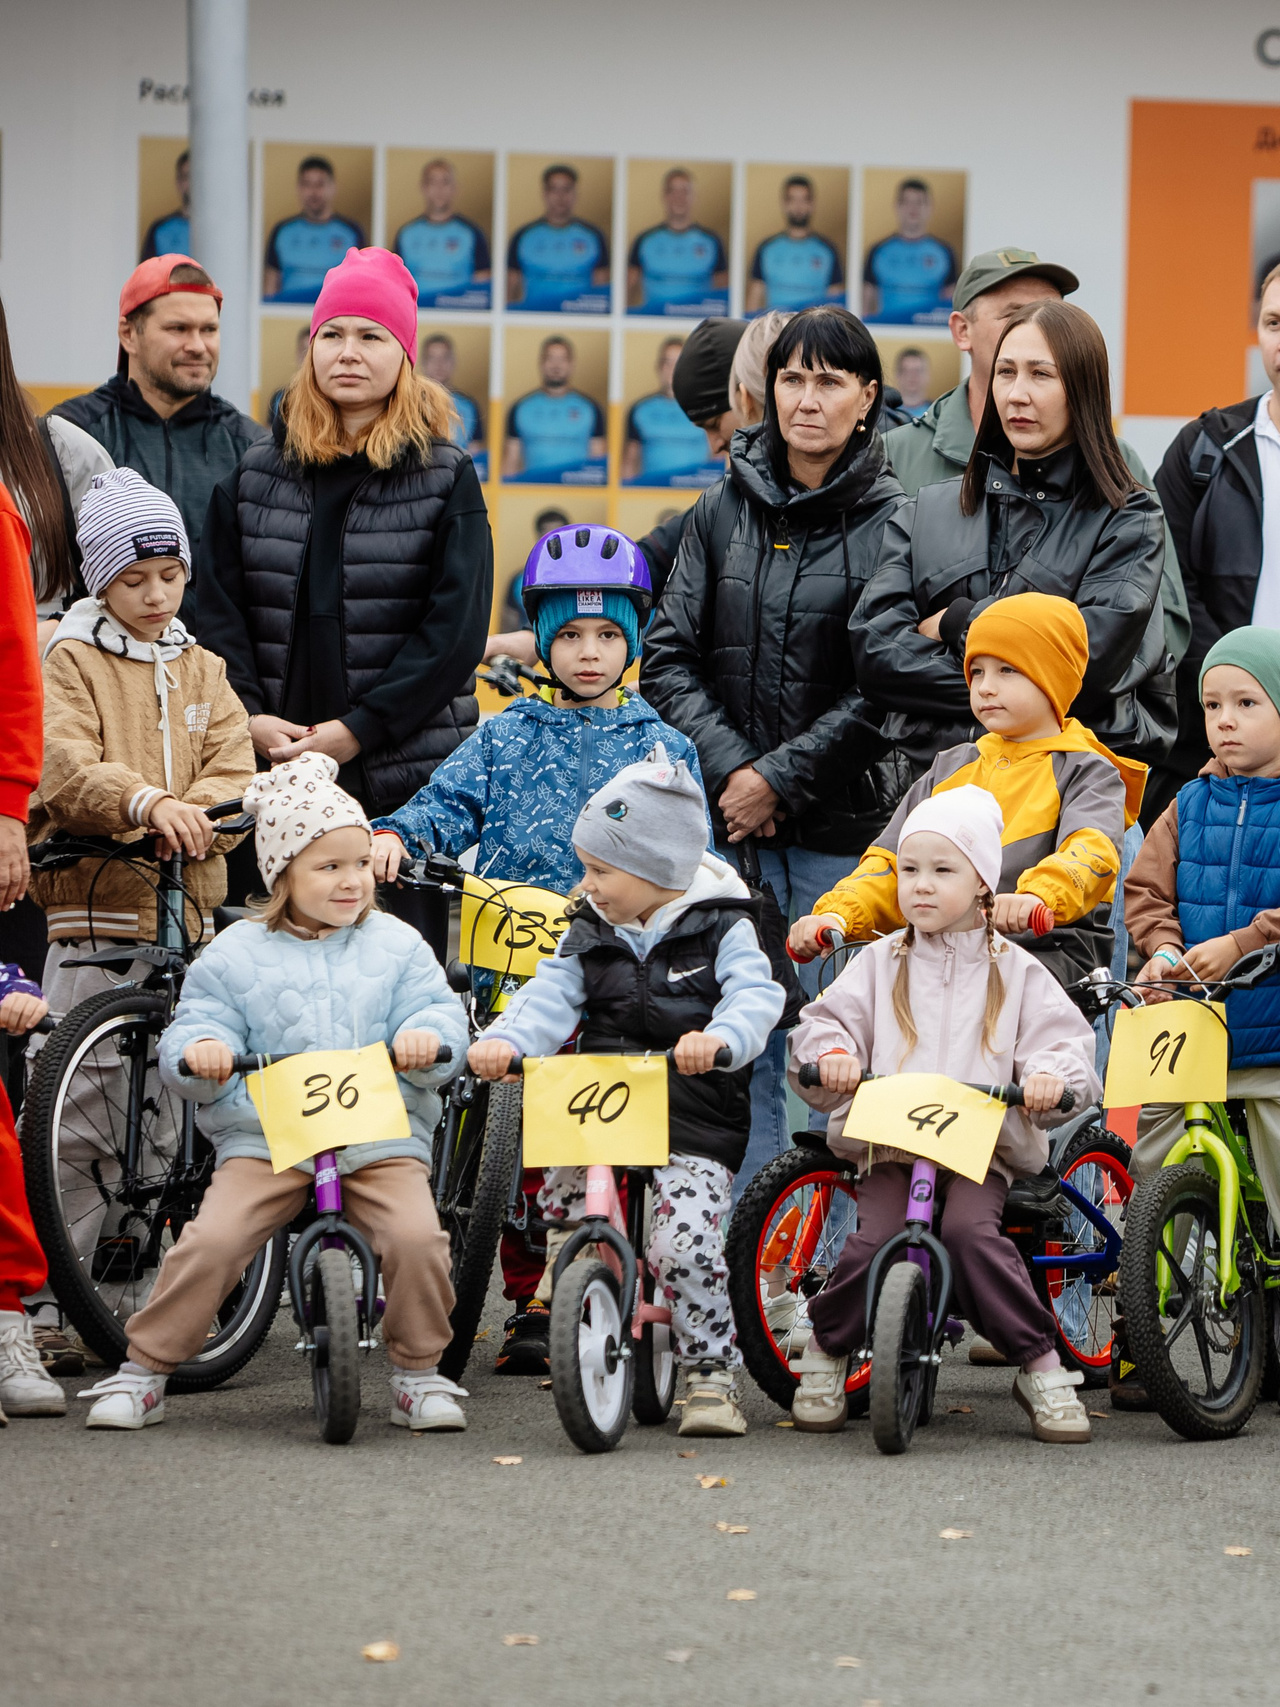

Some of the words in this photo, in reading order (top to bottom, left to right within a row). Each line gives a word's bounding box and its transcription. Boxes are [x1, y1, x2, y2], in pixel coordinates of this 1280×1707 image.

[1149, 1029, 1187, 1077] 91
[302, 1073, 359, 1117] 36
[567, 1081, 630, 1125] 40
[907, 1103, 959, 1138] 41
